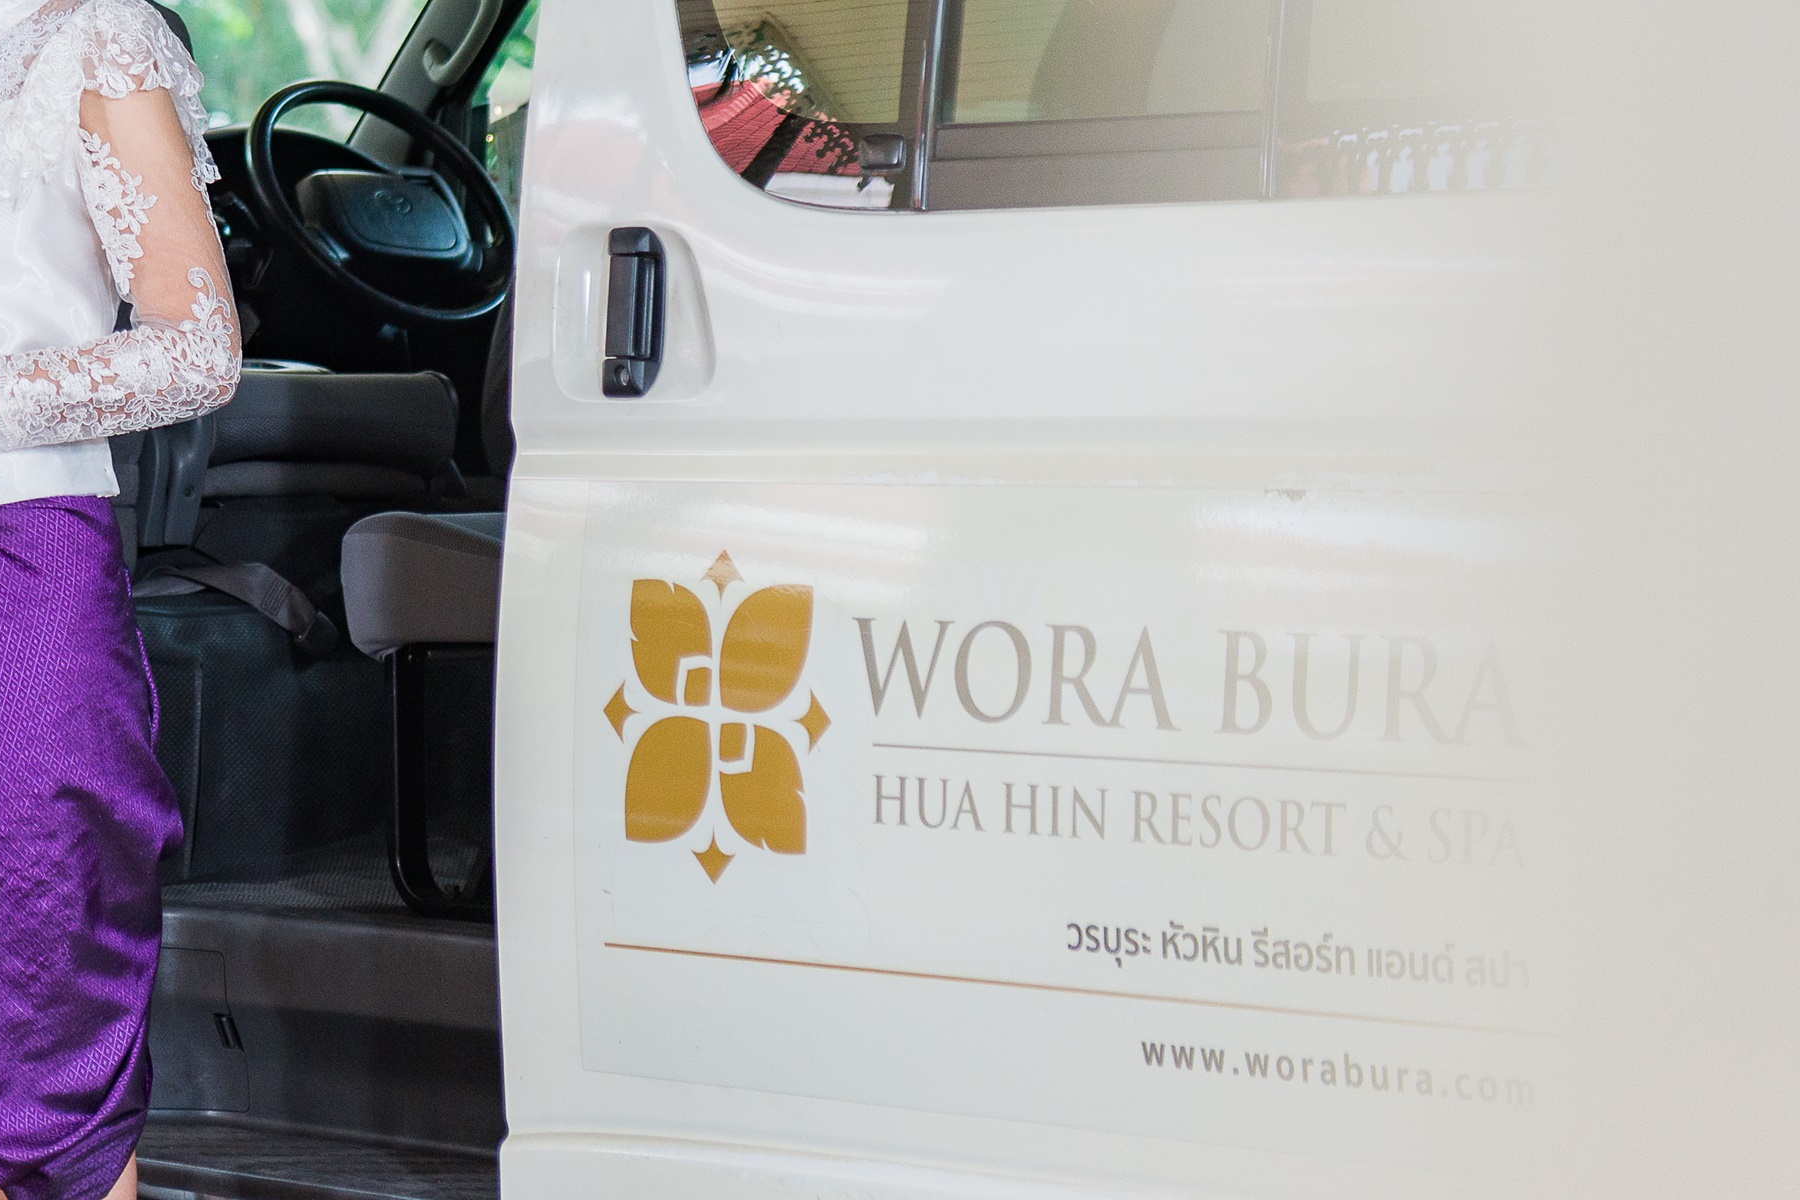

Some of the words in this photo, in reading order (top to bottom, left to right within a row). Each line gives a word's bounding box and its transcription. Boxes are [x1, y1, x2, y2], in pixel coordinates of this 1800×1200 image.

[852, 617, 1182, 731] WORA
[1214, 629, 1534, 749] BURA
[872, 773, 987, 832] HUA
[1003, 782, 1110, 841] HIN
[1130, 789, 1348, 857] RESORT
[1365, 804, 1409, 863] &
[1427, 807, 1528, 870] SPA
[1066, 922, 1152, 969] วรบุระ
[1161, 919, 1244, 967] หัวหิน
[1250, 926, 1357, 977] รีสอร์ท
[1367, 942, 1456, 985] แอนด์
[1465, 949, 1530, 990] สปา
[1141, 1040, 1536, 1106] www.worabura.com
